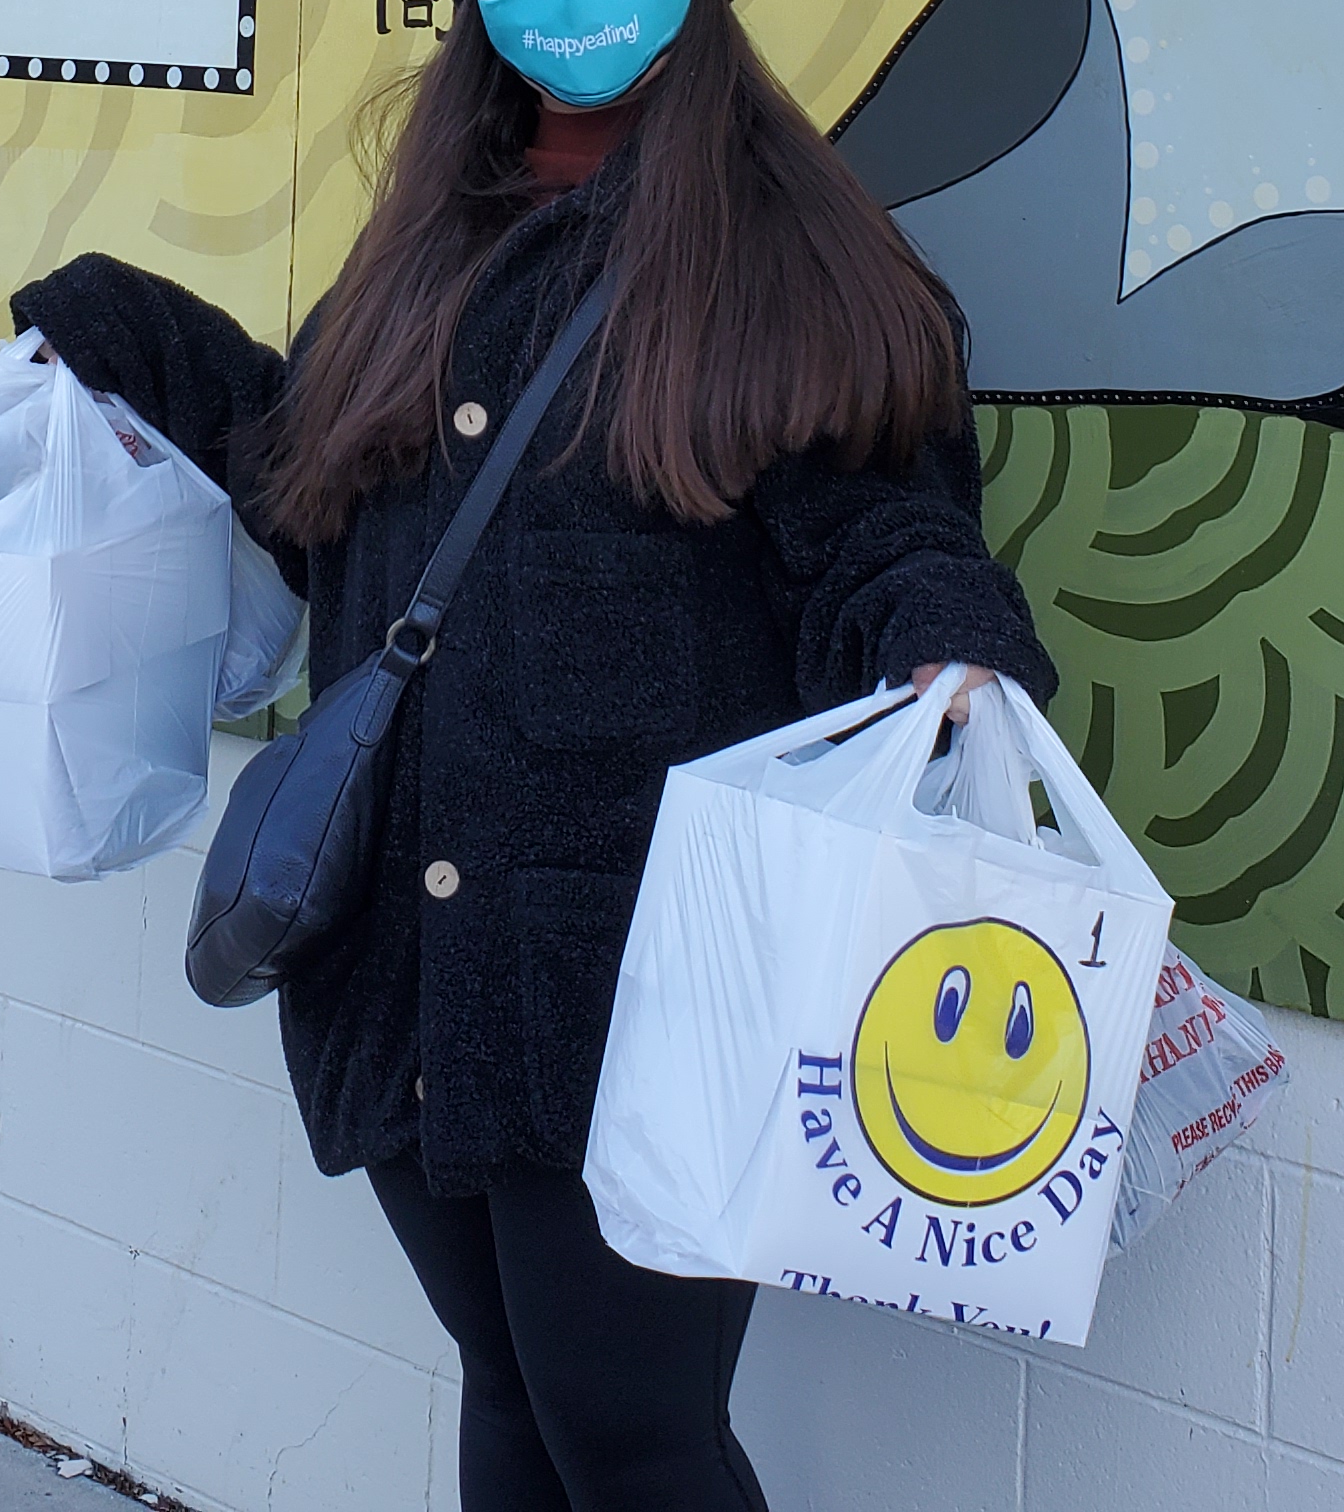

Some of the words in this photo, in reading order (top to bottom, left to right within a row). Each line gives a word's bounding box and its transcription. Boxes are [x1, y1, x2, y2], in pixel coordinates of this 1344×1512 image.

[522, 13, 640, 60] #happyeating!
[1078, 910, 1107, 968] 1
[1171, 1116, 1210, 1155] PLEASE
[1232, 1070, 1270, 1099] THIS
[1263, 1044, 1287, 1076] BA
[797, 1049, 862, 1207] Have
[861, 1196, 903, 1249] A
[915, 1214, 1038, 1267] Nice
[1037, 1105, 1124, 1226] Day
